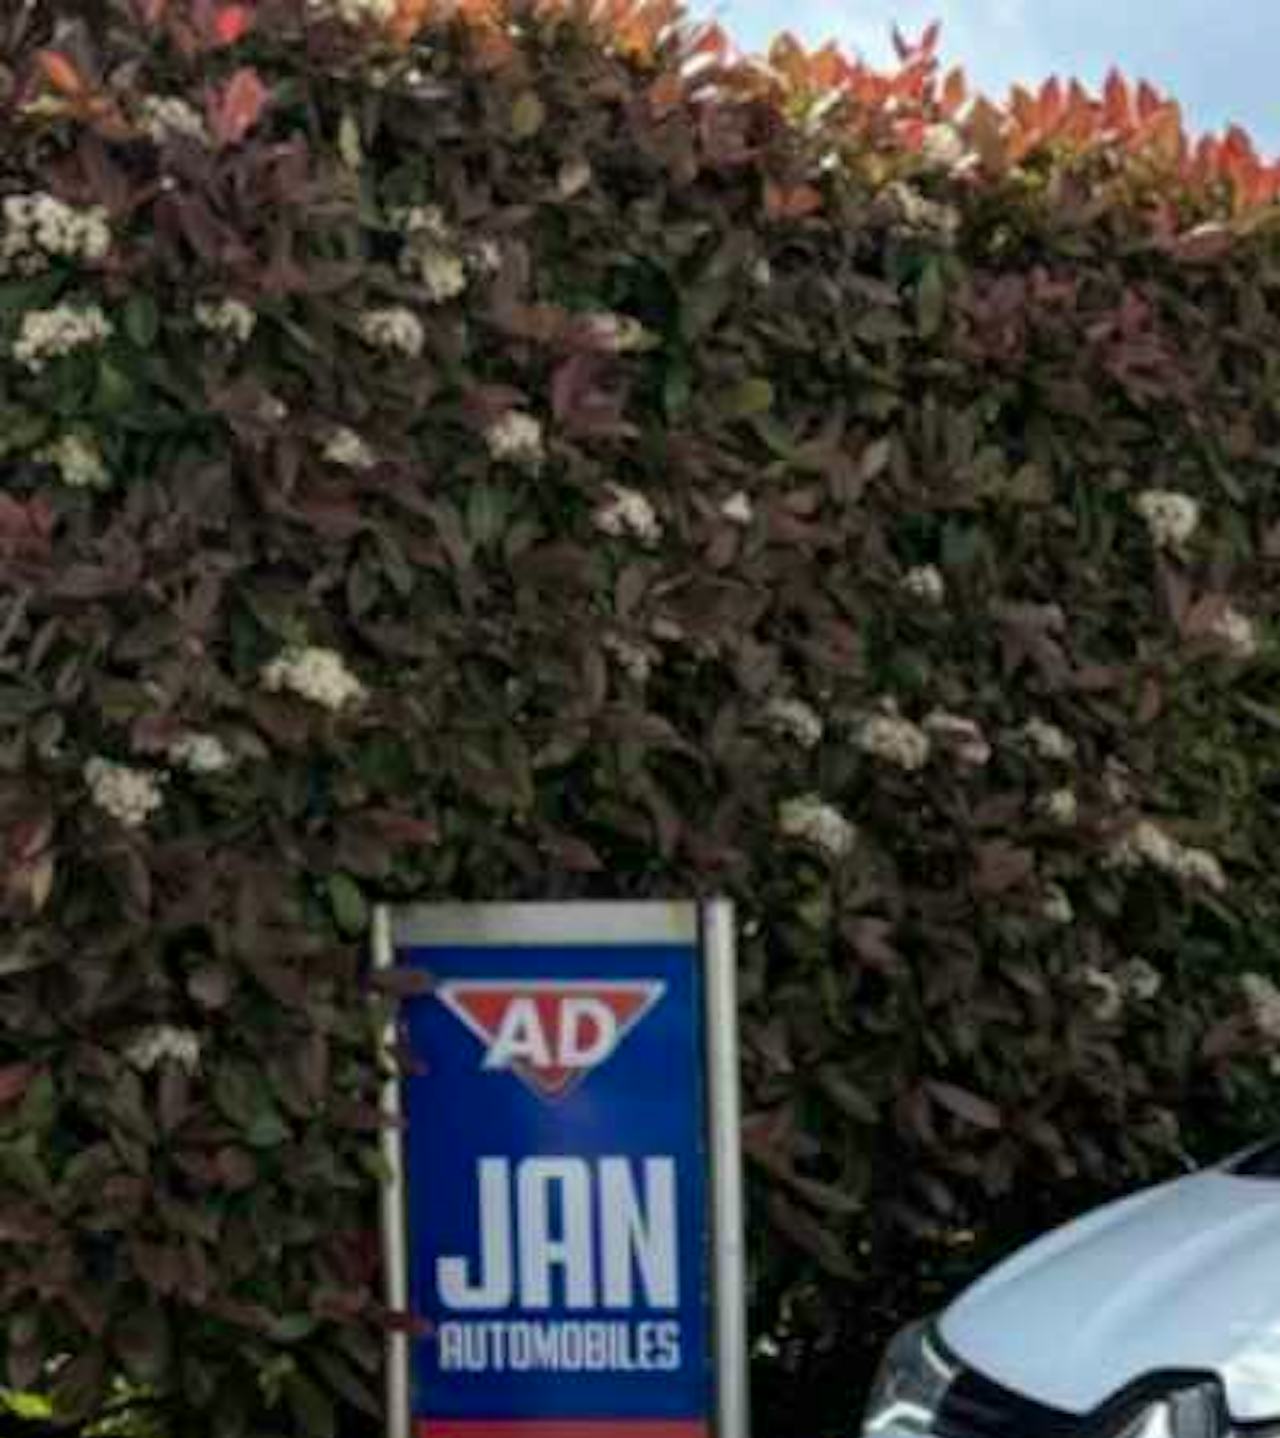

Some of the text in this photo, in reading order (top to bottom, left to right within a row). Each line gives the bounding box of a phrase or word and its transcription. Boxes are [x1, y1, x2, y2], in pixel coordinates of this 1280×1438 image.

[481, 998, 617, 1070] AD
[436, 1155, 679, 1309] JAN
[439, 1321, 682, 1372] AUTOMOBILES
